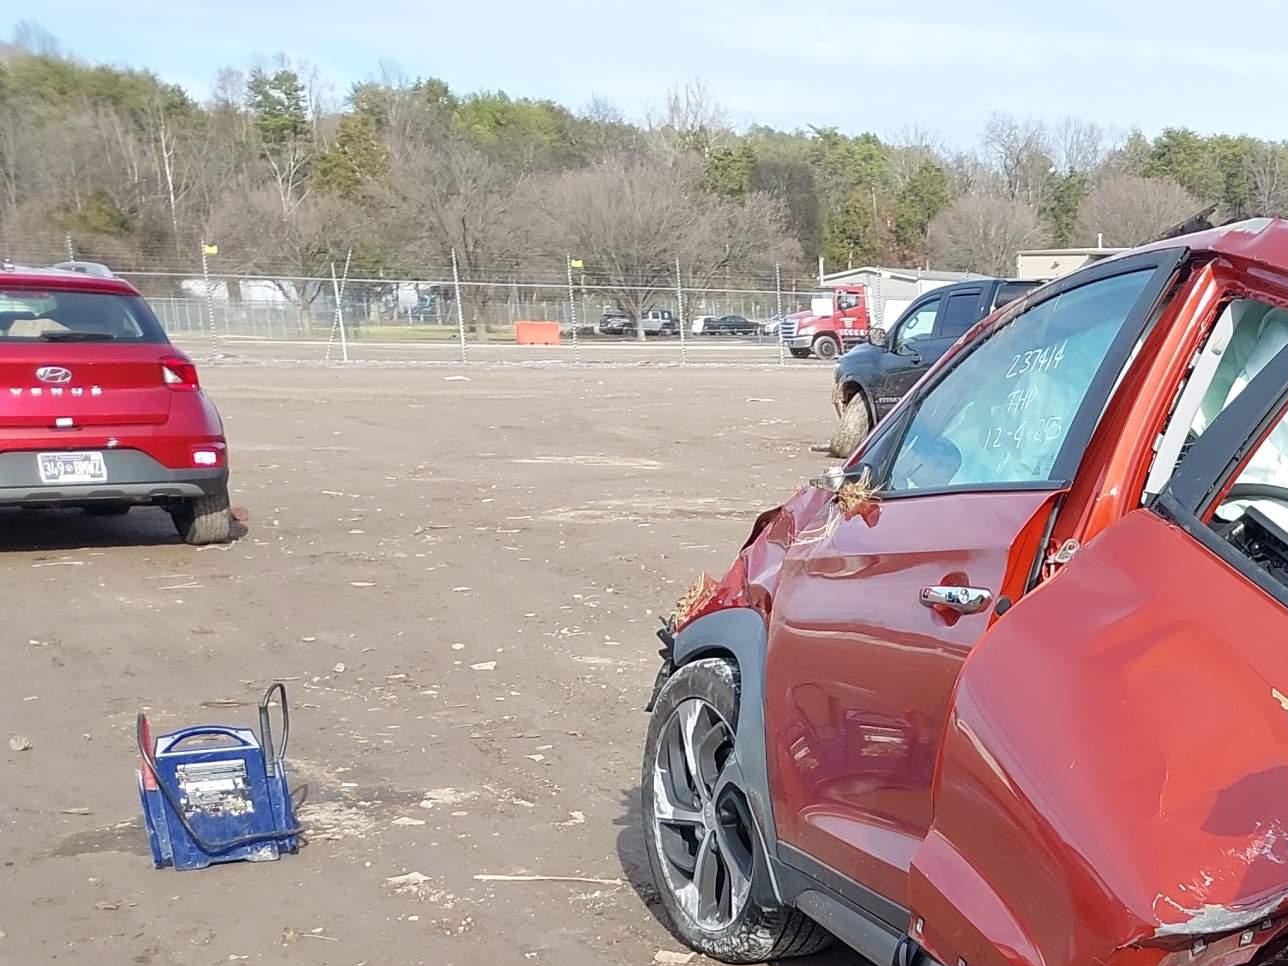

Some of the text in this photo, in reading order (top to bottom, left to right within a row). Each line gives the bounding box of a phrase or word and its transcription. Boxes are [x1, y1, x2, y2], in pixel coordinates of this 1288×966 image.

[1005, 338, 1068, 379] 237414
[9, 385, 103, 396] VENUE
[43, 461, 65, 476] 349
